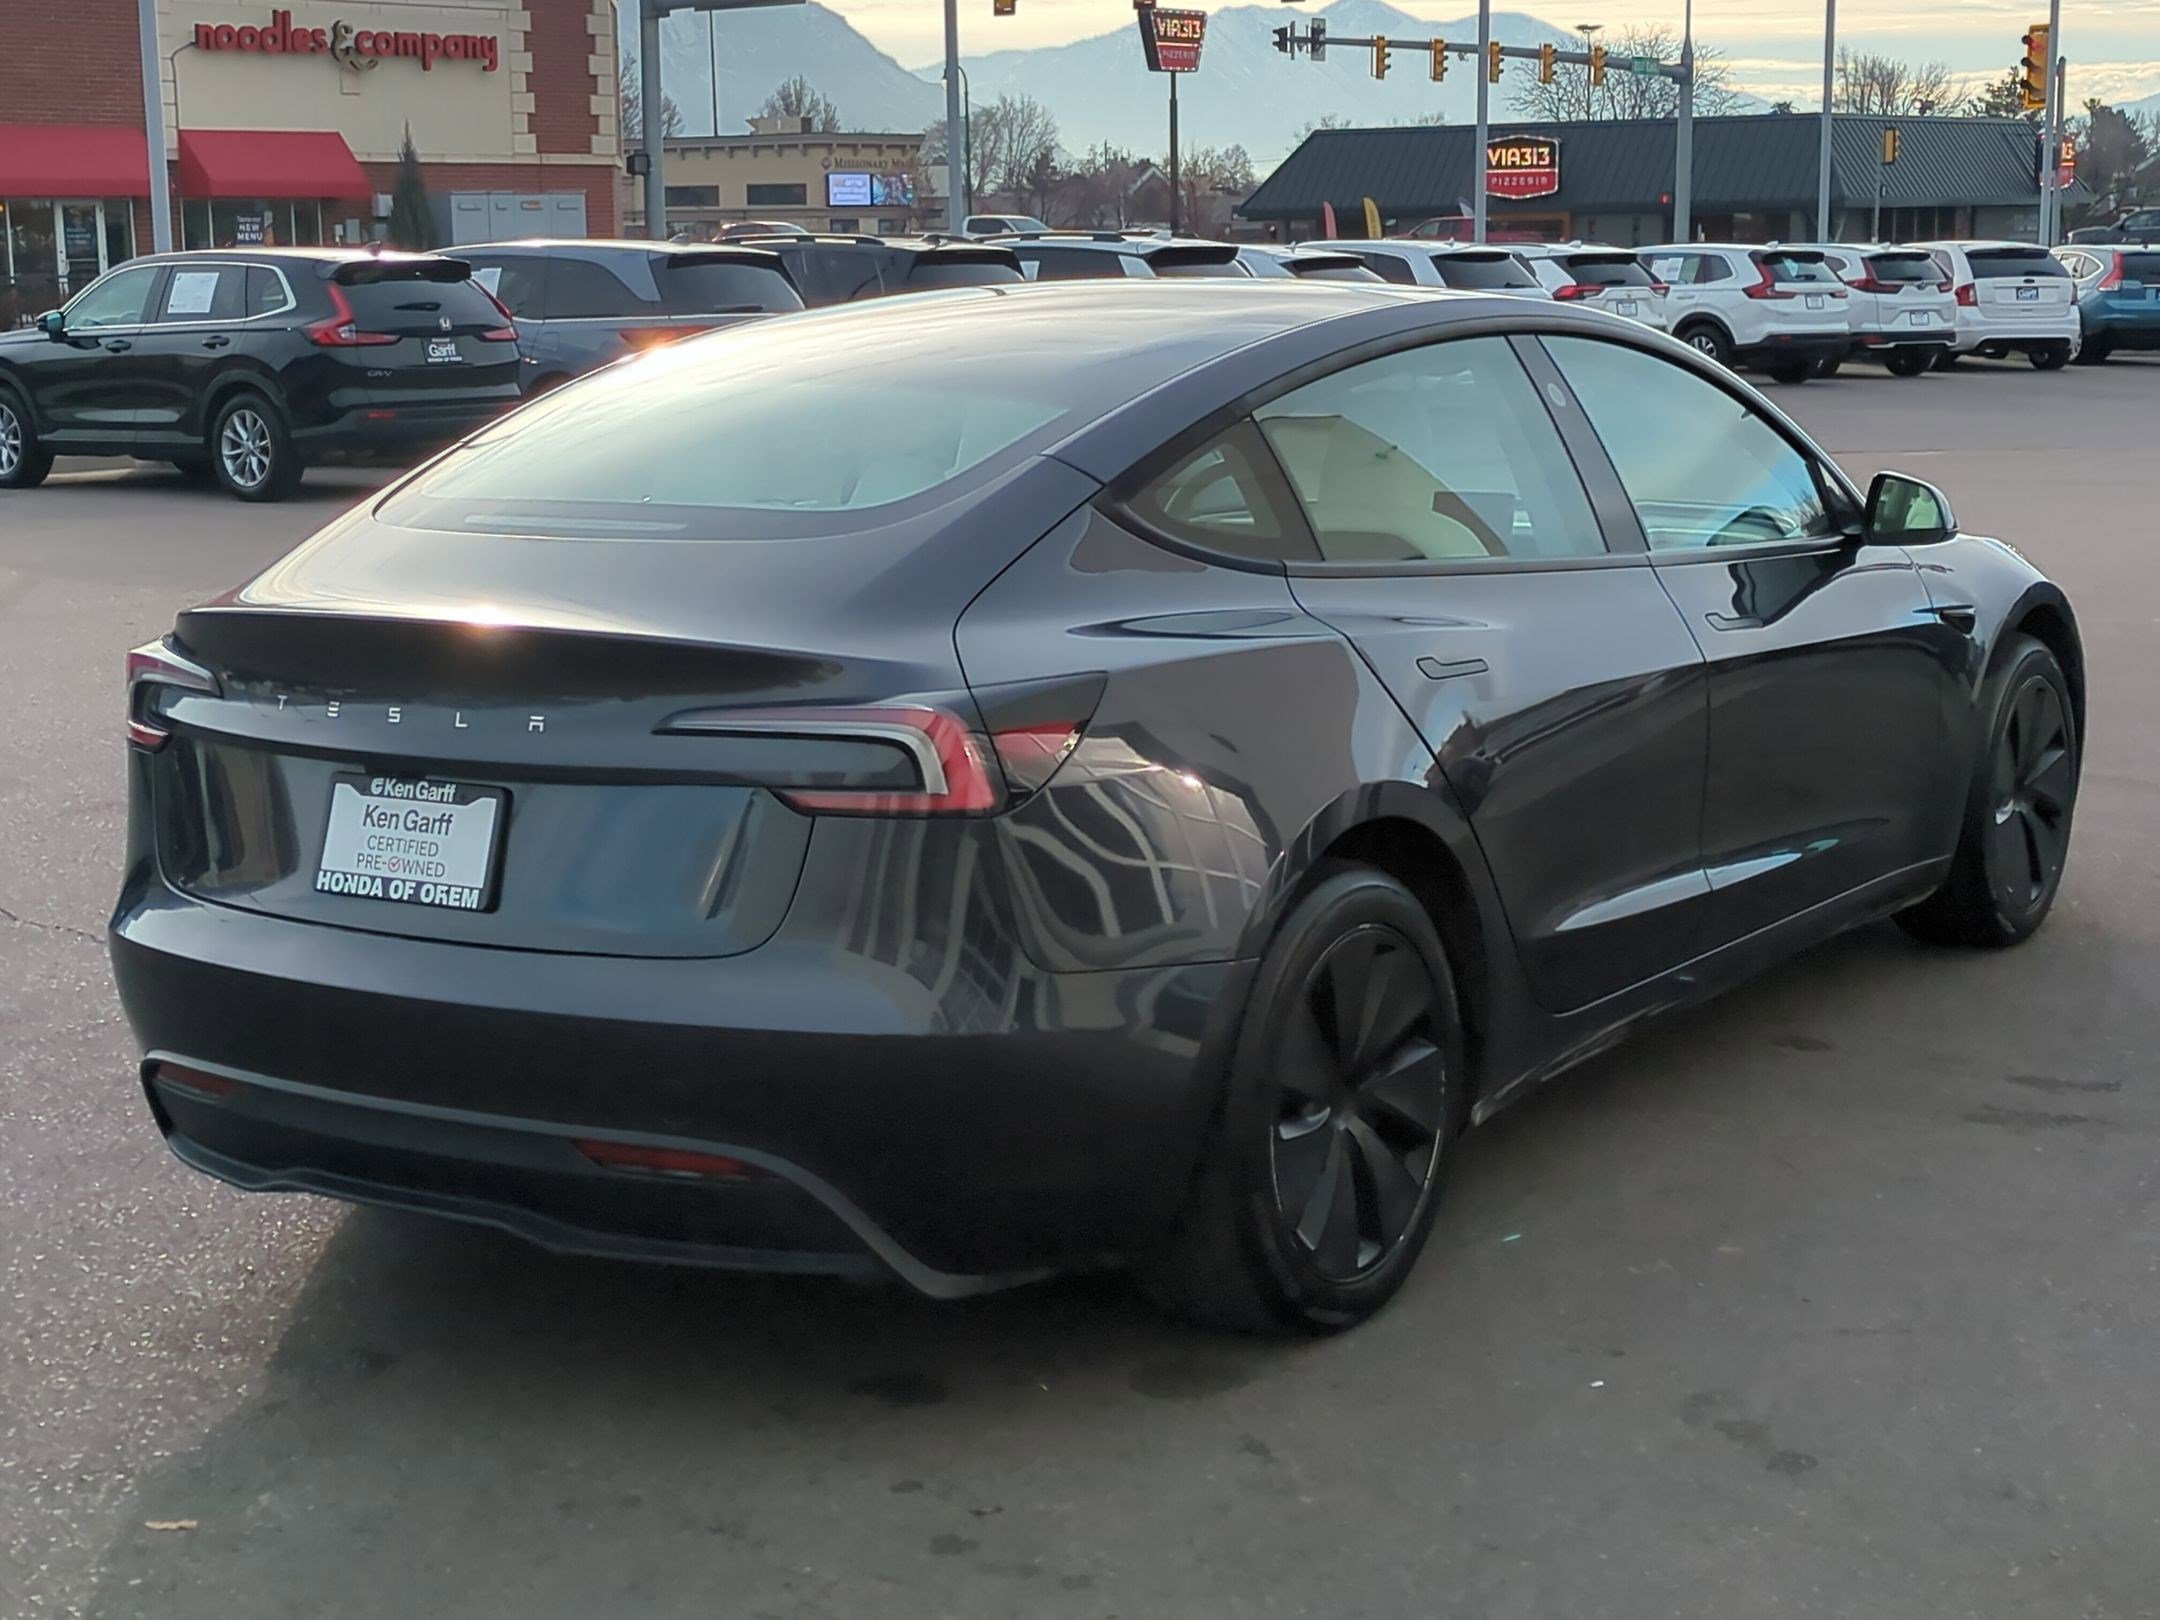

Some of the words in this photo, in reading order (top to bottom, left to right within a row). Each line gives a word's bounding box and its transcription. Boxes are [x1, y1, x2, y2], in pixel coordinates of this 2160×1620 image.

[1156, 17, 1201, 38] VIA313
[195, 10, 327, 54] noodles
[331, 19, 379, 70] &
[355, 29, 498, 71] company
[1487, 147, 1550, 166] VIA313
[1491, 176, 1548, 186] PIZZERIA
[237, 232, 263, 241] MENU
[239, 223, 260, 232] NEW
[277, 694, 545, 732] TESLA
[384, 778, 415, 799] Ken
[415, 781, 457, 802] Garff
[362, 804, 401, 831] Ken
[403, 809, 453, 836] Garff
[367, 835, 439, 858] CERTIFIED
[316, 870, 384, 898] HONDA
[389, 879, 416, 901] OF
[419, 885, 480, 910] OREM
